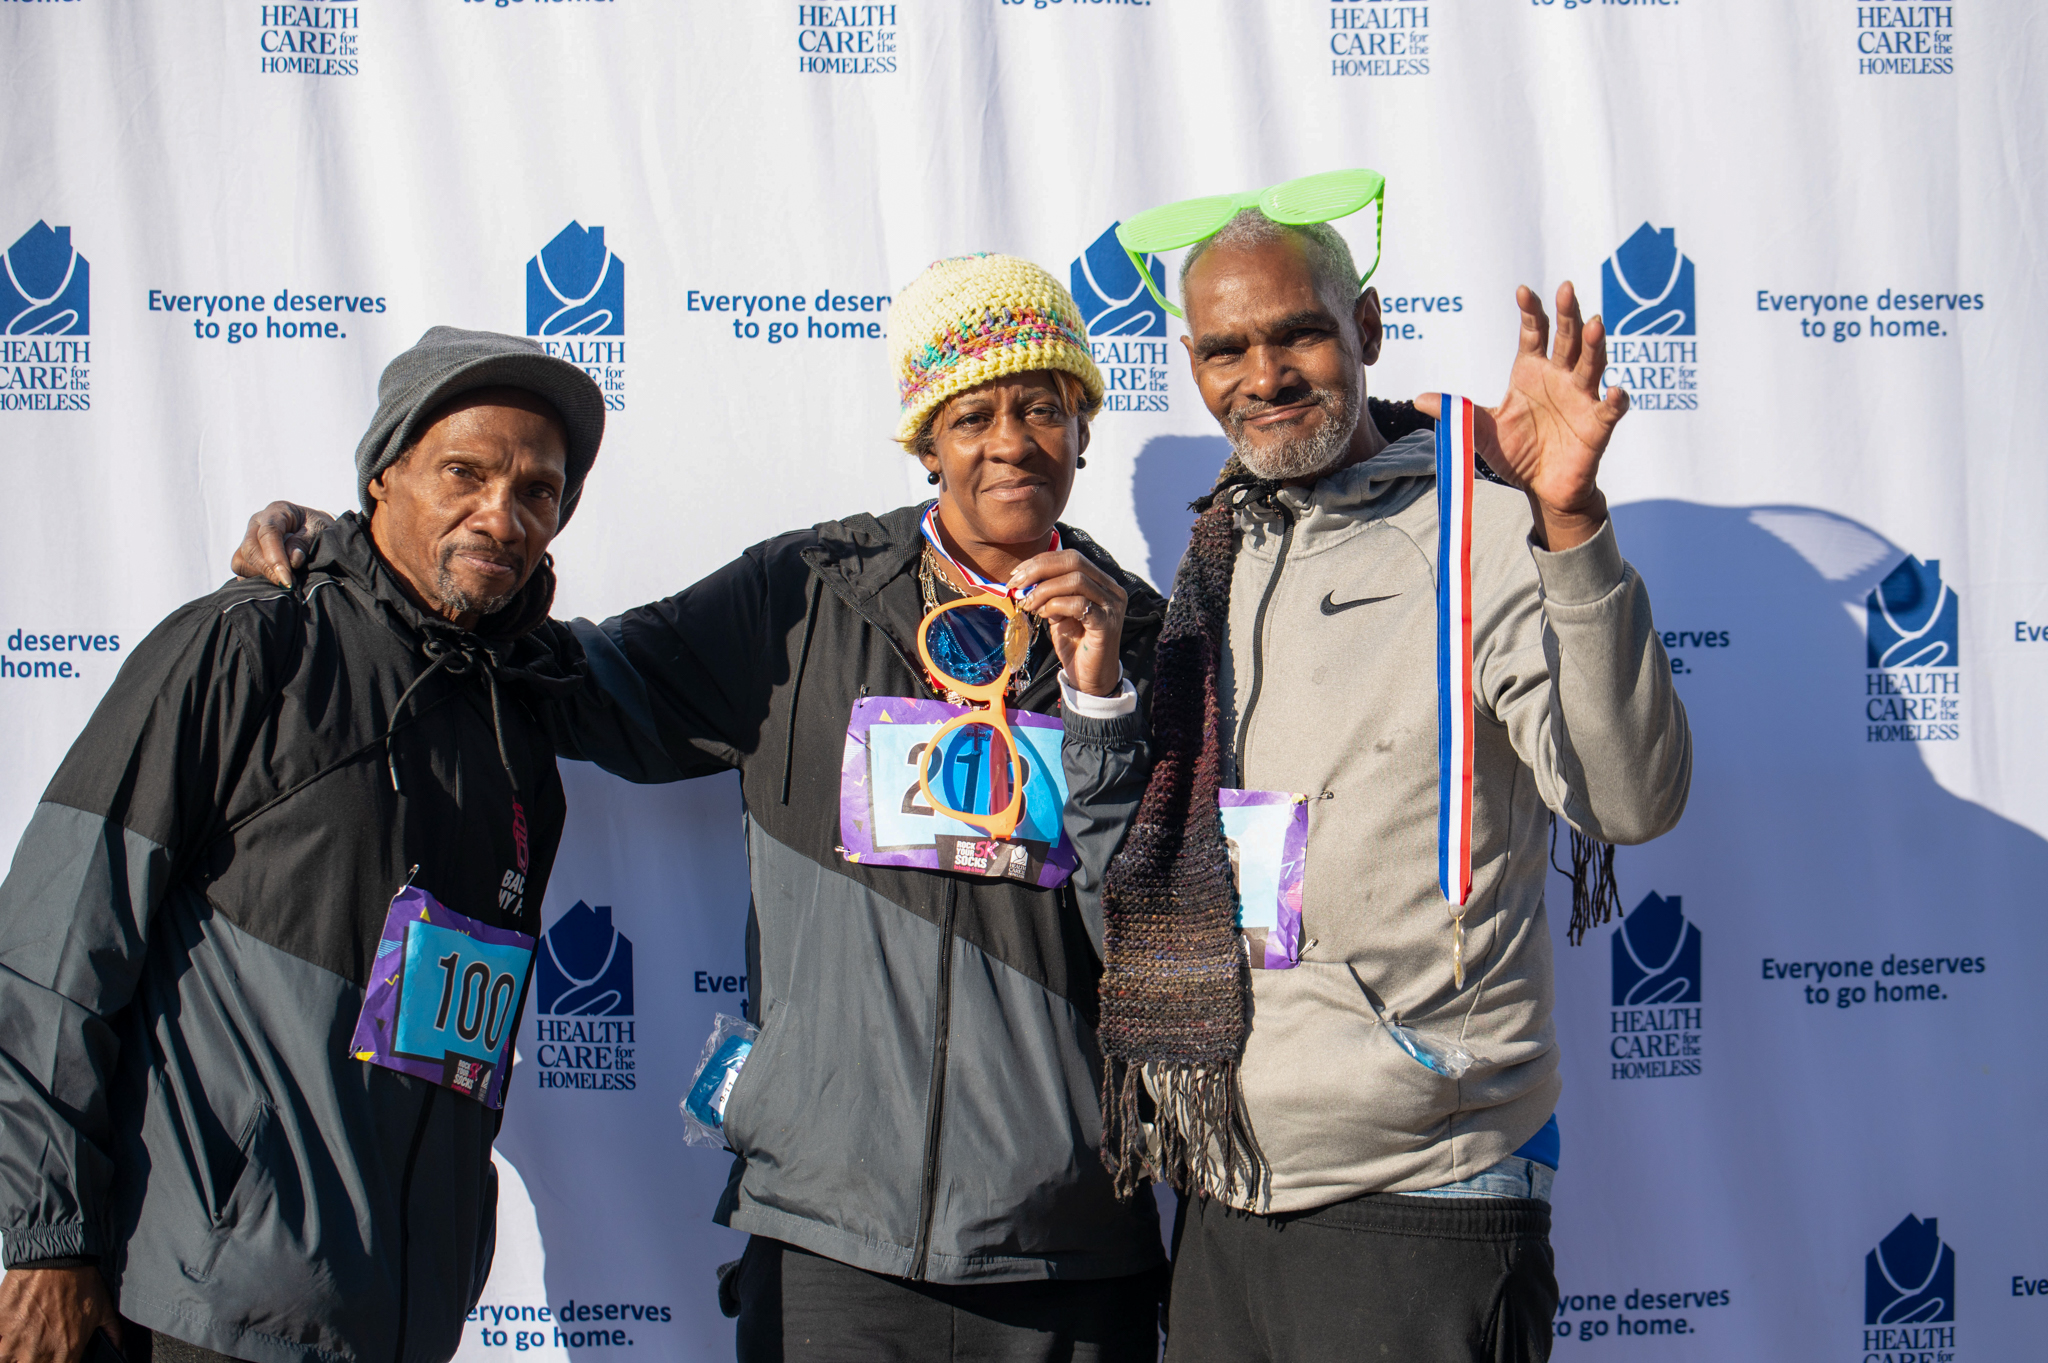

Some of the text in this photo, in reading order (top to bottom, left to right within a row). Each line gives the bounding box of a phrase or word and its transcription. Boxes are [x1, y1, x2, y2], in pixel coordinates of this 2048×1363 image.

[261, 6, 359, 29] HEALTH
[799, 5, 897, 26] HEALTH
[1330, 8, 1429, 29] HEALTH
[1857, 7, 1953, 28] HEALTH
[260, 31, 358, 55] CARE for the
[798, 29, 896, 53] CARE for the
[1330, 32, 1429, 55] CARE for the
[1858, 31, 1953, 54] CARE for the
[261, 57, 359, 76] HOMELESS
[799, 57, 897, 74] HOMELESS
[1332, 60, 1430, 76] HOMELESS
[1859, 58, 1953, 74] HOMELESS
[149, 290, 387, 317] Everyone deserves
[687, 289, 892, 317] Everyone deser
[1382, 296, 1463, 313] serves
[1757, 289, 1984, 316] Everyone deserves
[194, 316, 347, 344] to go home.
[733, 316, 888, 344] to go home.
[1382, 324, 1423, 340] me.
[1801, 315, 1947, 342] to go home.
[540, 342, 625, 363] EALTH
[1090, 343, 1168, 364] EALTH
[71, 366, 90, 378] for
[605, 366, 624, 378] for
[1104, 367, 1168, 391] RE for the
[1602, 366, 1697, 390] CARE for the
[71, 379, 90, 390] the
[605, 379, 624, 390] the
[1101, 395, 1169, 412] MELESS
[1602, 393, 1698, 411] MELESS
[8, 628, 120, 651] deserves
[1, 655, 80, 678] home.
[1866, 673, 1960, 695] HEALTH
[1866, 697, 1959, 721] CARE for the
[1867, 725, 1959, 742] HOMELESS
[954, 855, 988, 869] SOCKS
[975, 841, 999, 860] 5K
[1762, 954, 1985, 983] Everyone deserves
[433, 951, 516, 1053] 100
[1805, 981, 1947, 1008] to go home.
[537, 1020, 636, 1043] HEALTH
[1611, 1008, 1702, 1033] HEALTH
[1611, 1032, 1700, 1059] CARE for the
[537, 1045, 636, 1070] CARE for the
[1611, 1059, 1701, 1079] HOMELESS
[538, 1072, 636, 1090] HOMELESS
[1625, 1288, 1730, 1310] deserves
[465, 1300, 672, 1326] eryone deserves
[1579, 1320, 1609, 1341] go
[1618, 1314, 1695, 1335] home.
[1863, 1327, 1955, 1351] HEALTH
[481, 1327, 634, 1352] to go home.
